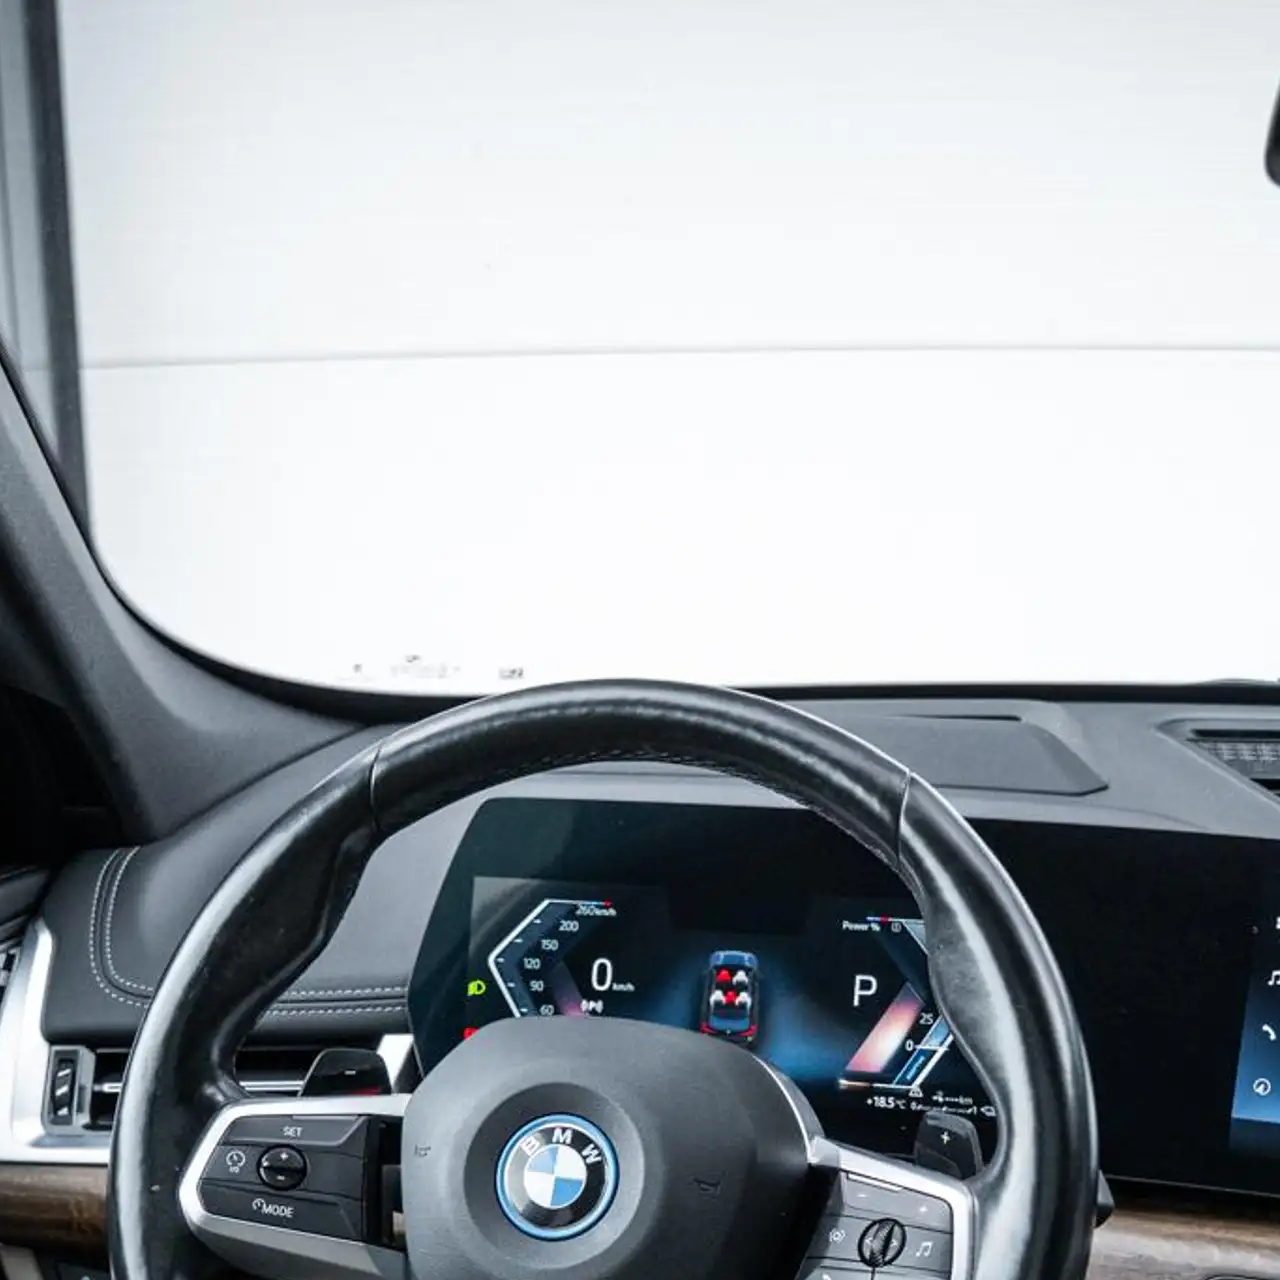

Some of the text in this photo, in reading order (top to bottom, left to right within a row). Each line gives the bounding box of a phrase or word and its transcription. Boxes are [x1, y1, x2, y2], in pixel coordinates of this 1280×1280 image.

[558, 920, 579, 932] 200
[842, 920, 869, 931] Power
[541, 939, 559, 951] 150
[523, 958, 541, 970] 120
[591, 957, 613, 992] 0
[529, 980, 545, 992] 90
[853, 974, 878, 1007] P
[539, 1004, 555, 1016] 60
[282, 1126, 303, 1138] SET
[519, 1126, 603, 1167] BMW
[261, 1203, 294, 1218] MODE
